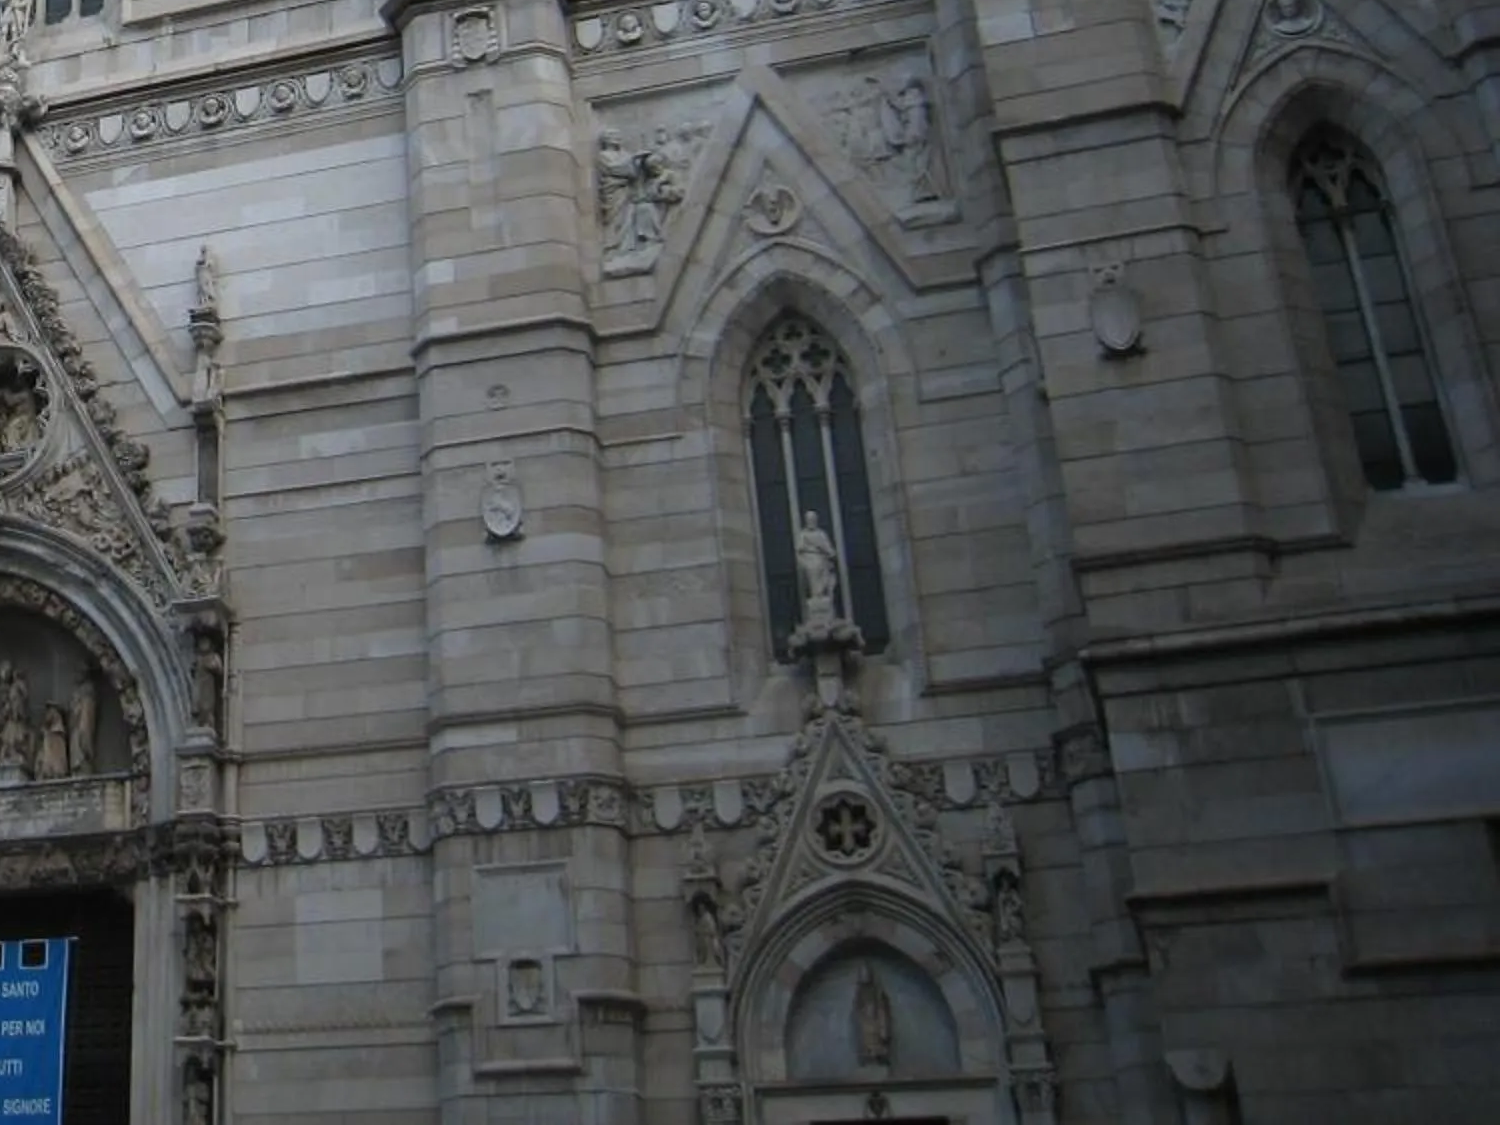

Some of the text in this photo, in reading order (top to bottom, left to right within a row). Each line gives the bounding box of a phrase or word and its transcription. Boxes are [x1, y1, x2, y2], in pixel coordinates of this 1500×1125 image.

[2, 981, 40, 998] SANTO
[1, 1020, 23, 1036] PER
[25, 1019, 46, 1036] NOI
[3, 1097, 51, 1116] SIGNORE
